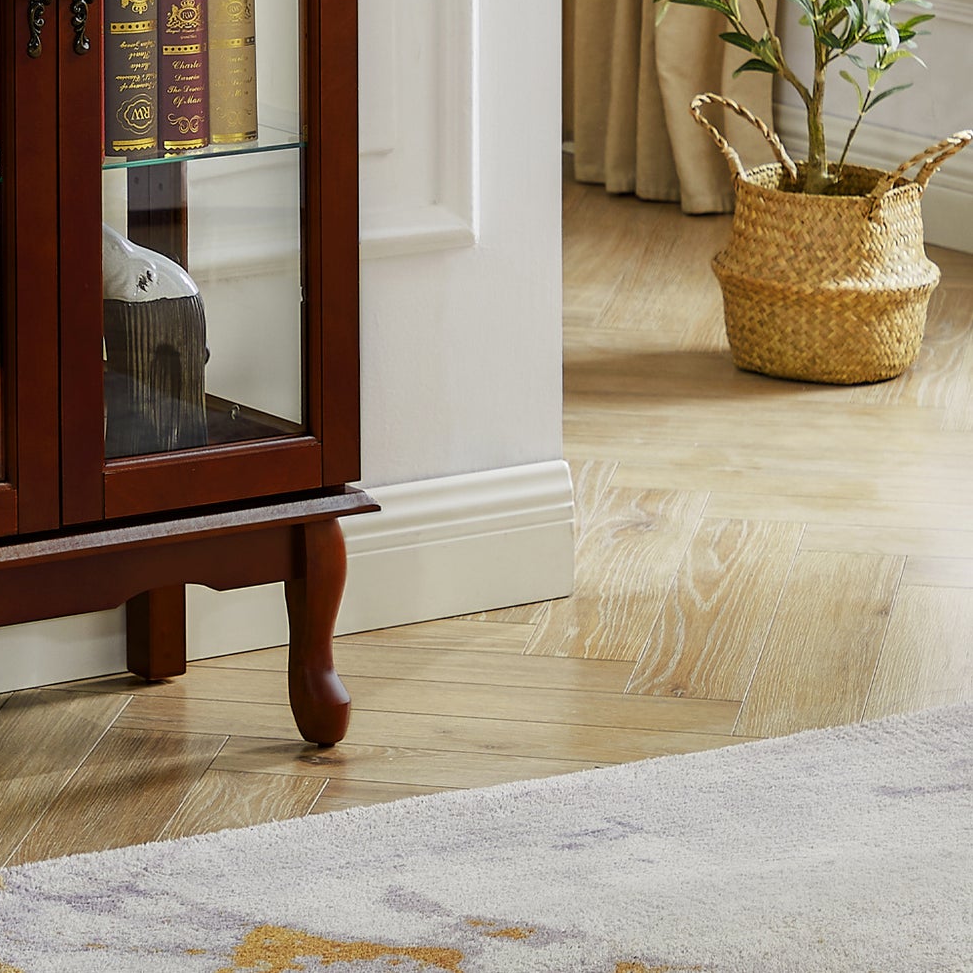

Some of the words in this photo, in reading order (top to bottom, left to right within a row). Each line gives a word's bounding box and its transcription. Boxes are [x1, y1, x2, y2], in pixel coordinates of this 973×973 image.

[174, 74, 200, 82] Darwin
[167, 85, 182, 94] The
[172, 96, 183, 108] Of
[183, 95, 202, 104] Man
[130, 106, 151, 121] RW
